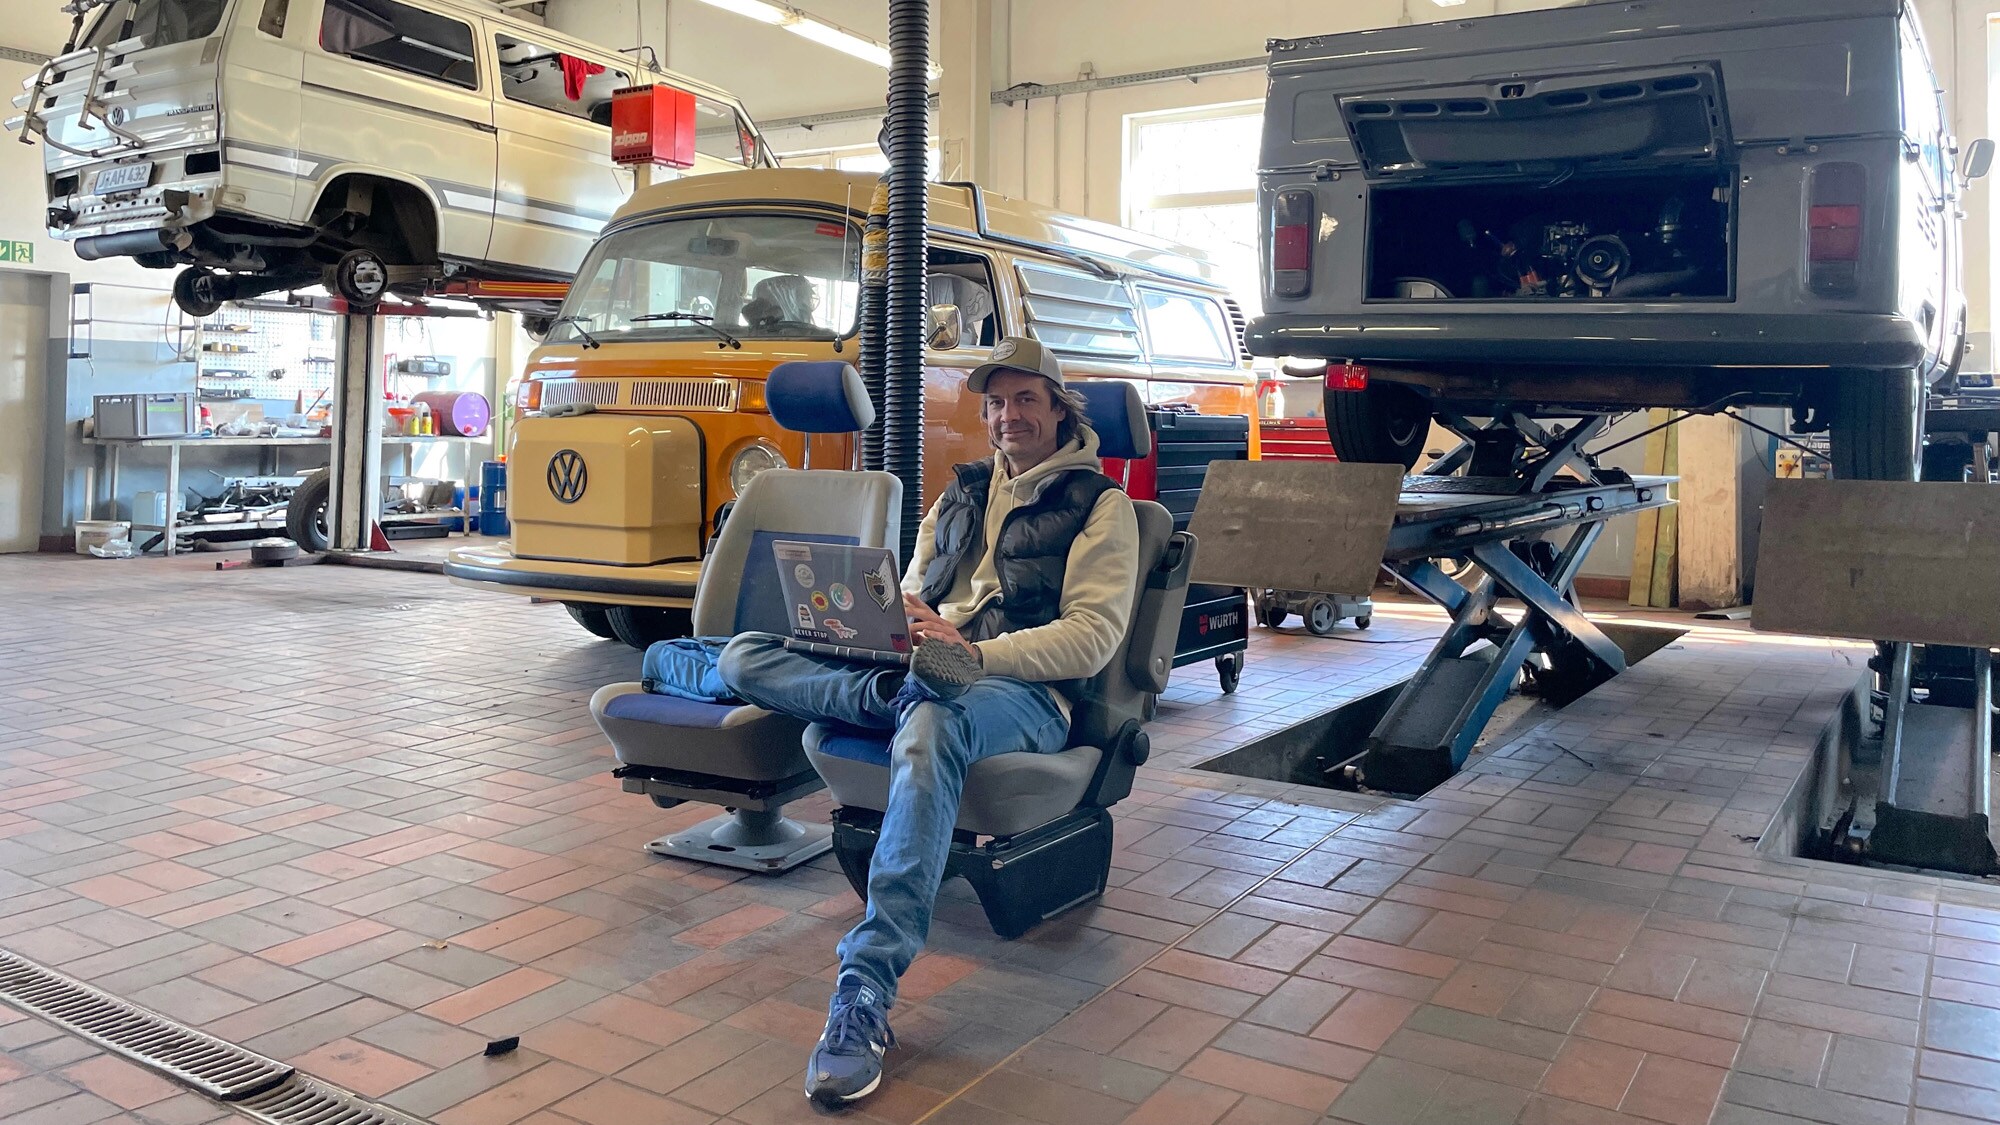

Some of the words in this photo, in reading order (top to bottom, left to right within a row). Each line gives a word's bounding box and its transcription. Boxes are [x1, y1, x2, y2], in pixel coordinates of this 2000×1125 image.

[614, 130, 648, 147] zippo
[127, 165, 147, 182] 432
[547, 448, 588, 504] VW
[1209, 611, 1239, 630] WÜRTH
[794, 628, 813, 637] NEVER
[813, 630, 828, 639] STOP
